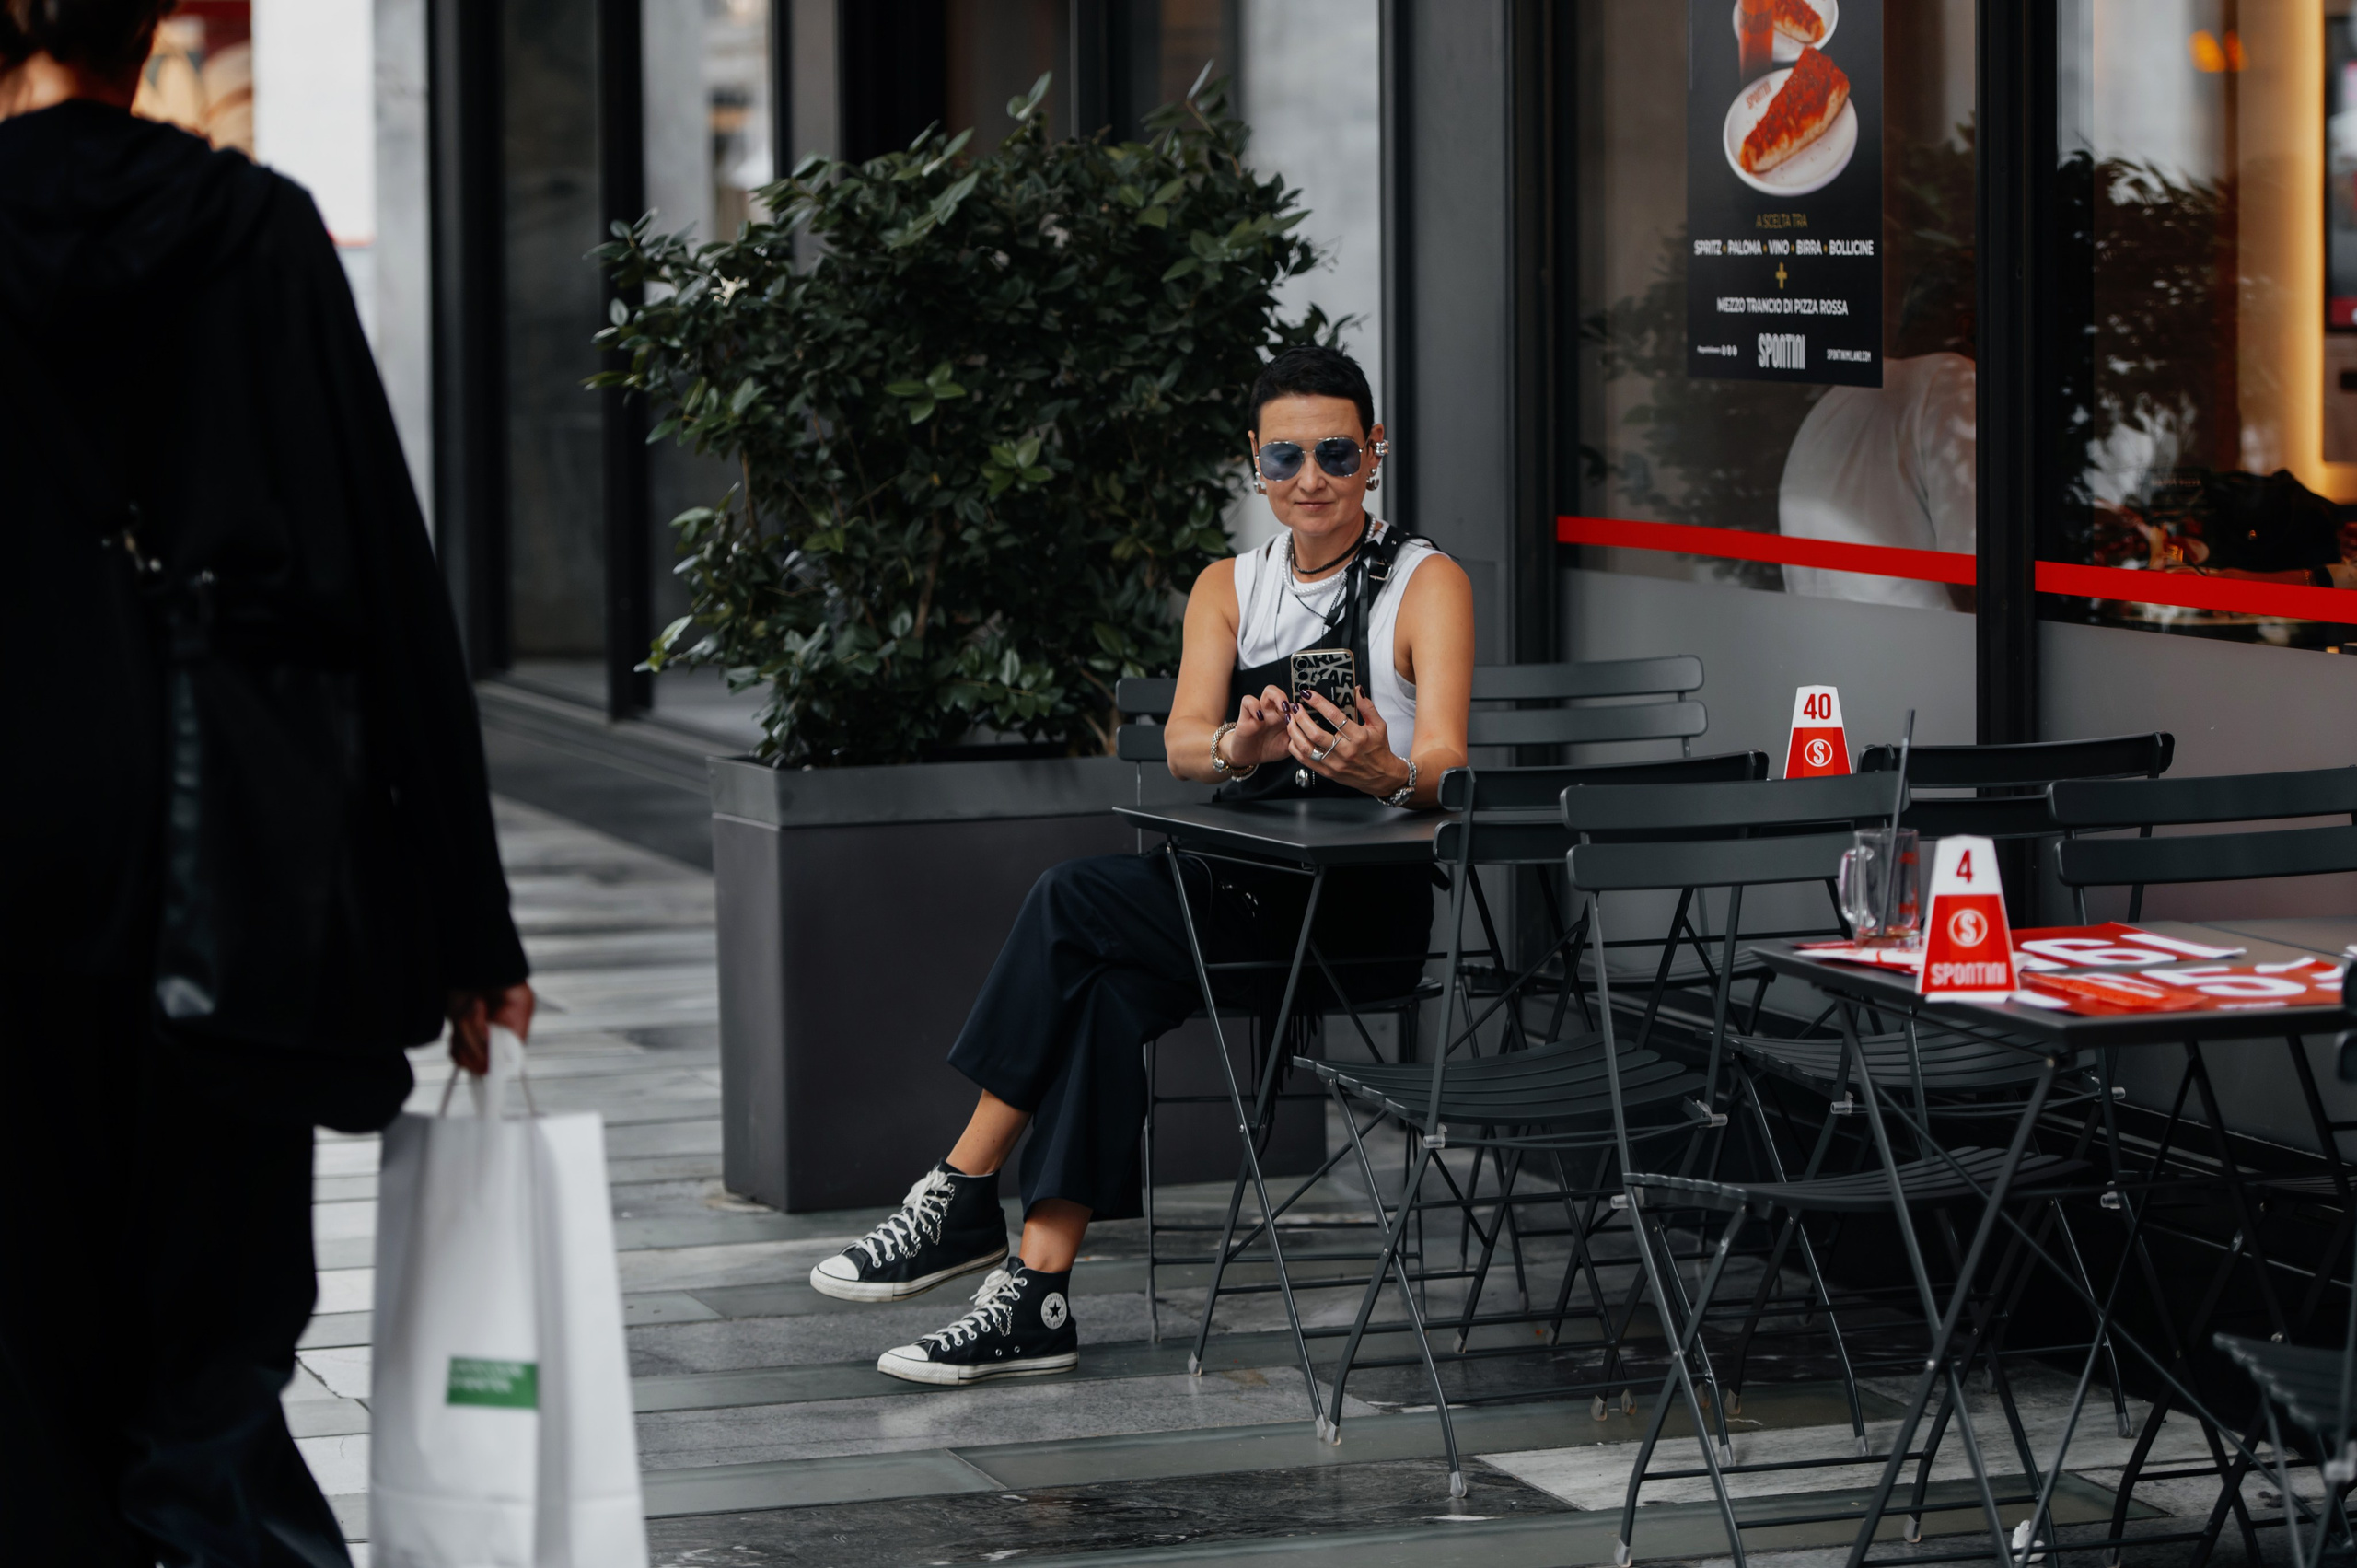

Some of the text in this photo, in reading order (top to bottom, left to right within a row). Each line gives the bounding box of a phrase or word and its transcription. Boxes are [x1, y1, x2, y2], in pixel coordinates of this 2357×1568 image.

[1793, 213, 1808, 228] TRA
[1694, 239, 1874, 256] SPRITZ PALOMA VINO BIRRA BOLLICINE
[1716, 296, 1849, 316] MEZZO TRANCIO DI PIZZA ROSSA
[1803, 693, 1832, 720] 40
[1956, 849, 1974, 884] 4
